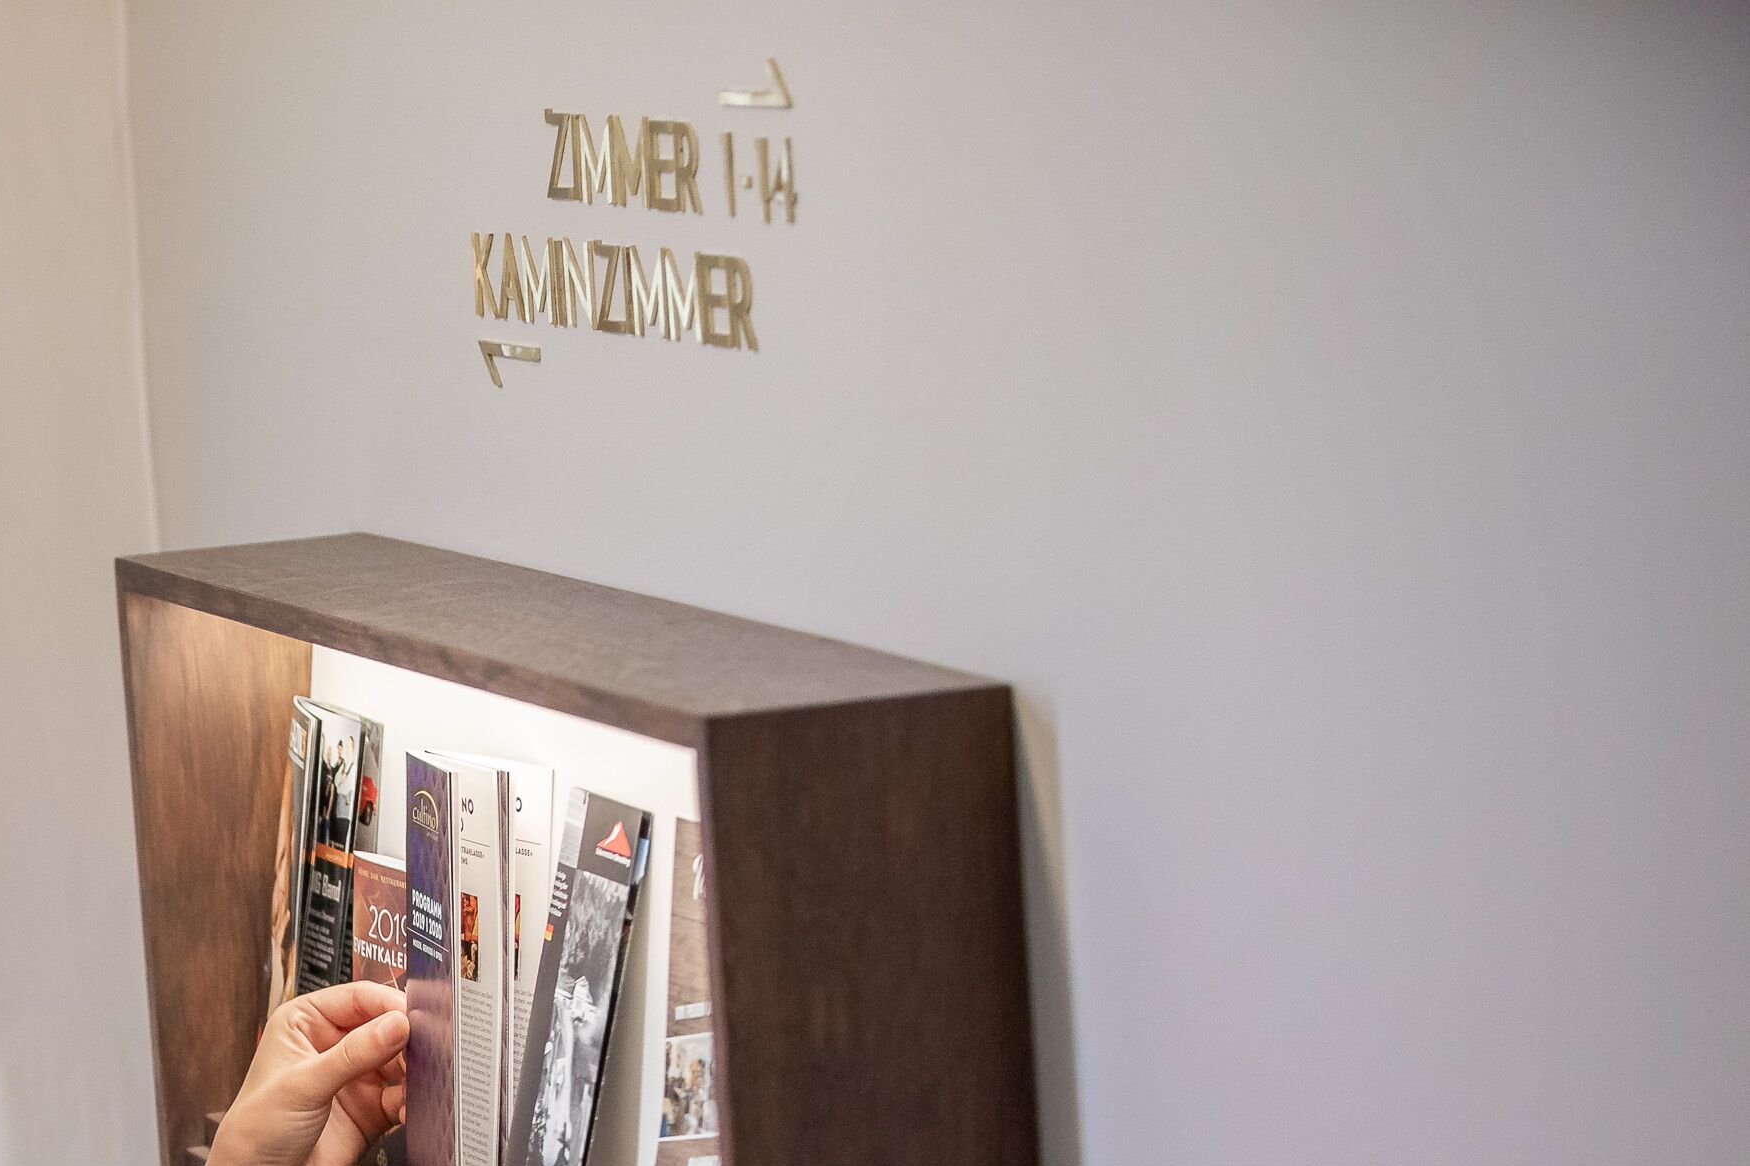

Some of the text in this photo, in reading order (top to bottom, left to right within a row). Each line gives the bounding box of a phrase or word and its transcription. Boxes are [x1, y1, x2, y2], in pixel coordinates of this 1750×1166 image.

[544, 108, 703, 215] ZIMMER
[470, 232, 759, 352] KAMINZIMMER
[411, 888, 442, 920] PROGRAMM
